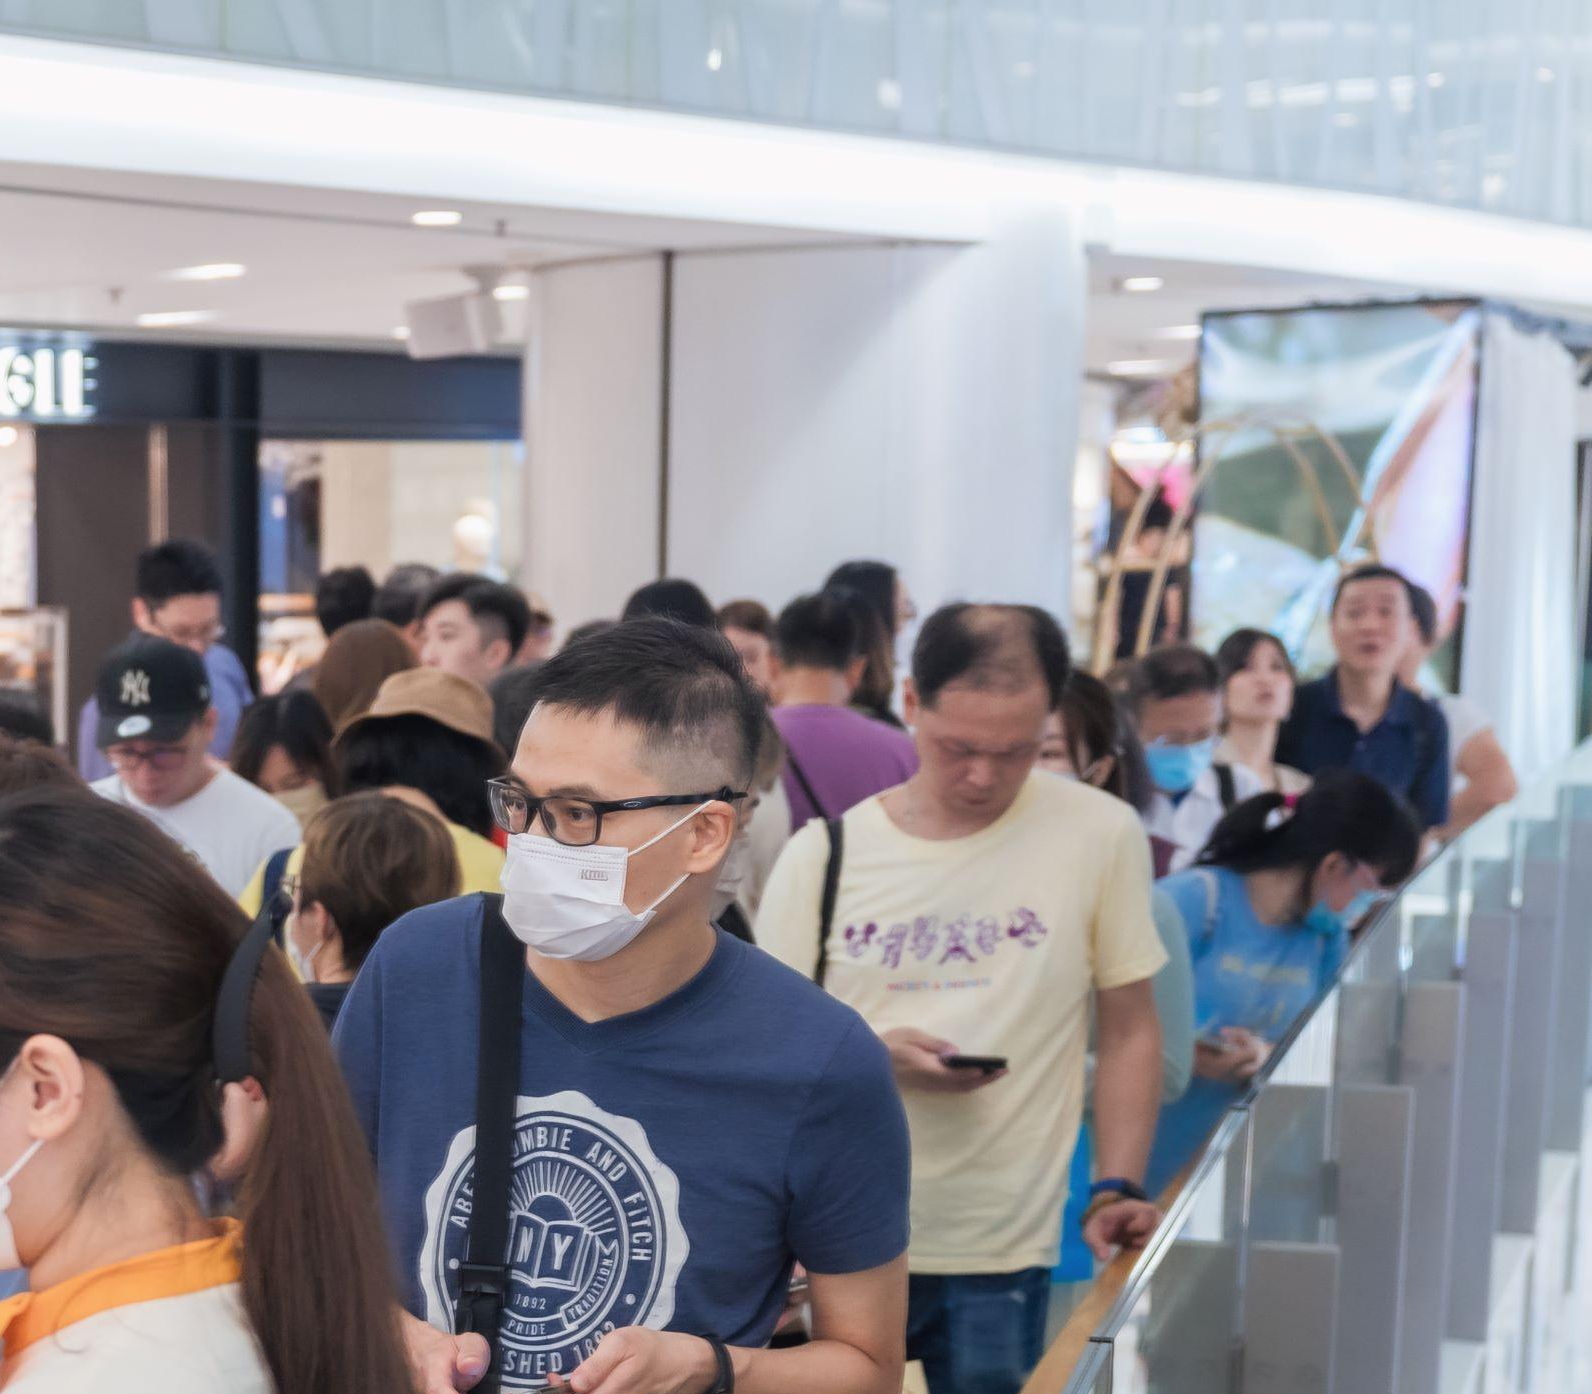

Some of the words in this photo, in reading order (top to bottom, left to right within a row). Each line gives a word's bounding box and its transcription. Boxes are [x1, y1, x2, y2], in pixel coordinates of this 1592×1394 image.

[450, 1127, 573, 1229] ABEMBIE
[585, 1141, 627, 1182] AND
[623, 1190, 653, 1262] FITCH
[567, 1258, 614, 1321] TRADITION
[507, 1319, 546, 1336] PRIDE
